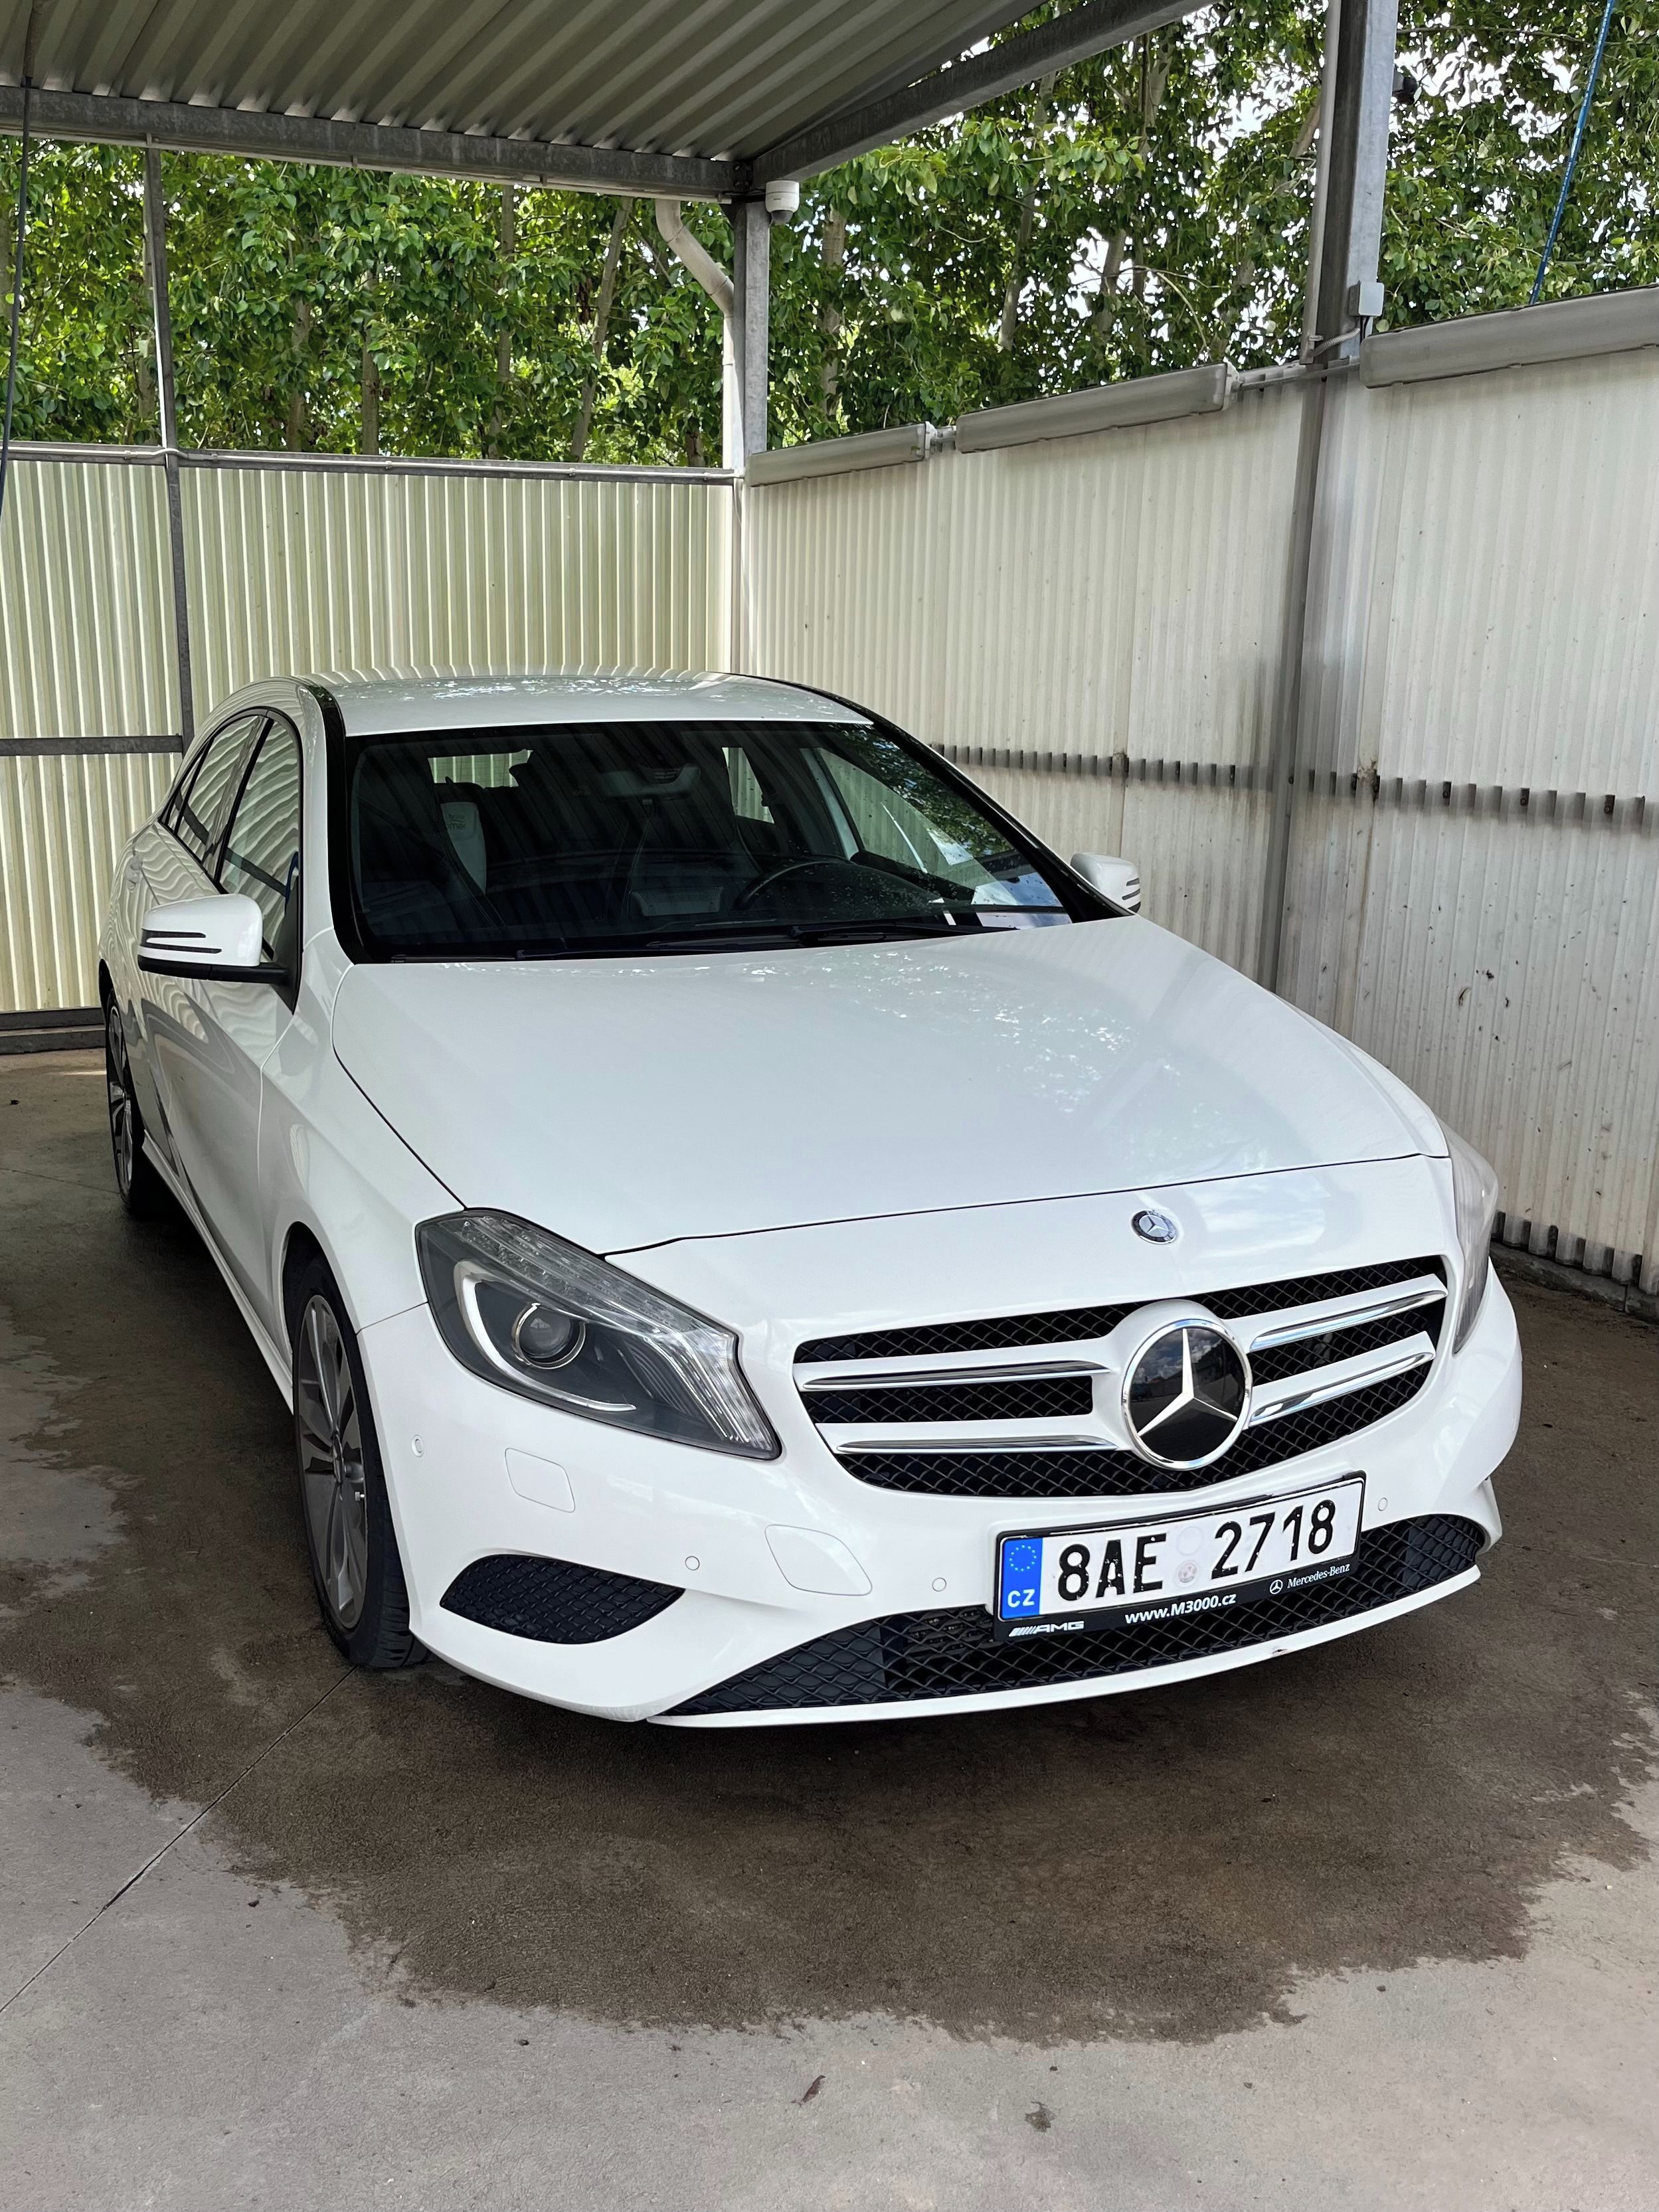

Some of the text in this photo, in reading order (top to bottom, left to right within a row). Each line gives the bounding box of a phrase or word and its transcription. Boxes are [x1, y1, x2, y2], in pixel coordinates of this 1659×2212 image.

[1057, 1499, 1336, 1602] 8AE 2718
[1286, 1563, 1351, 1589] Mercedes-Benz
[1007, 1588, 1035, 1608] CZ
[1124, 1592, 1237, 1624] www.M3000.cz
[1034, 1620, 1085, 1634] AMG
